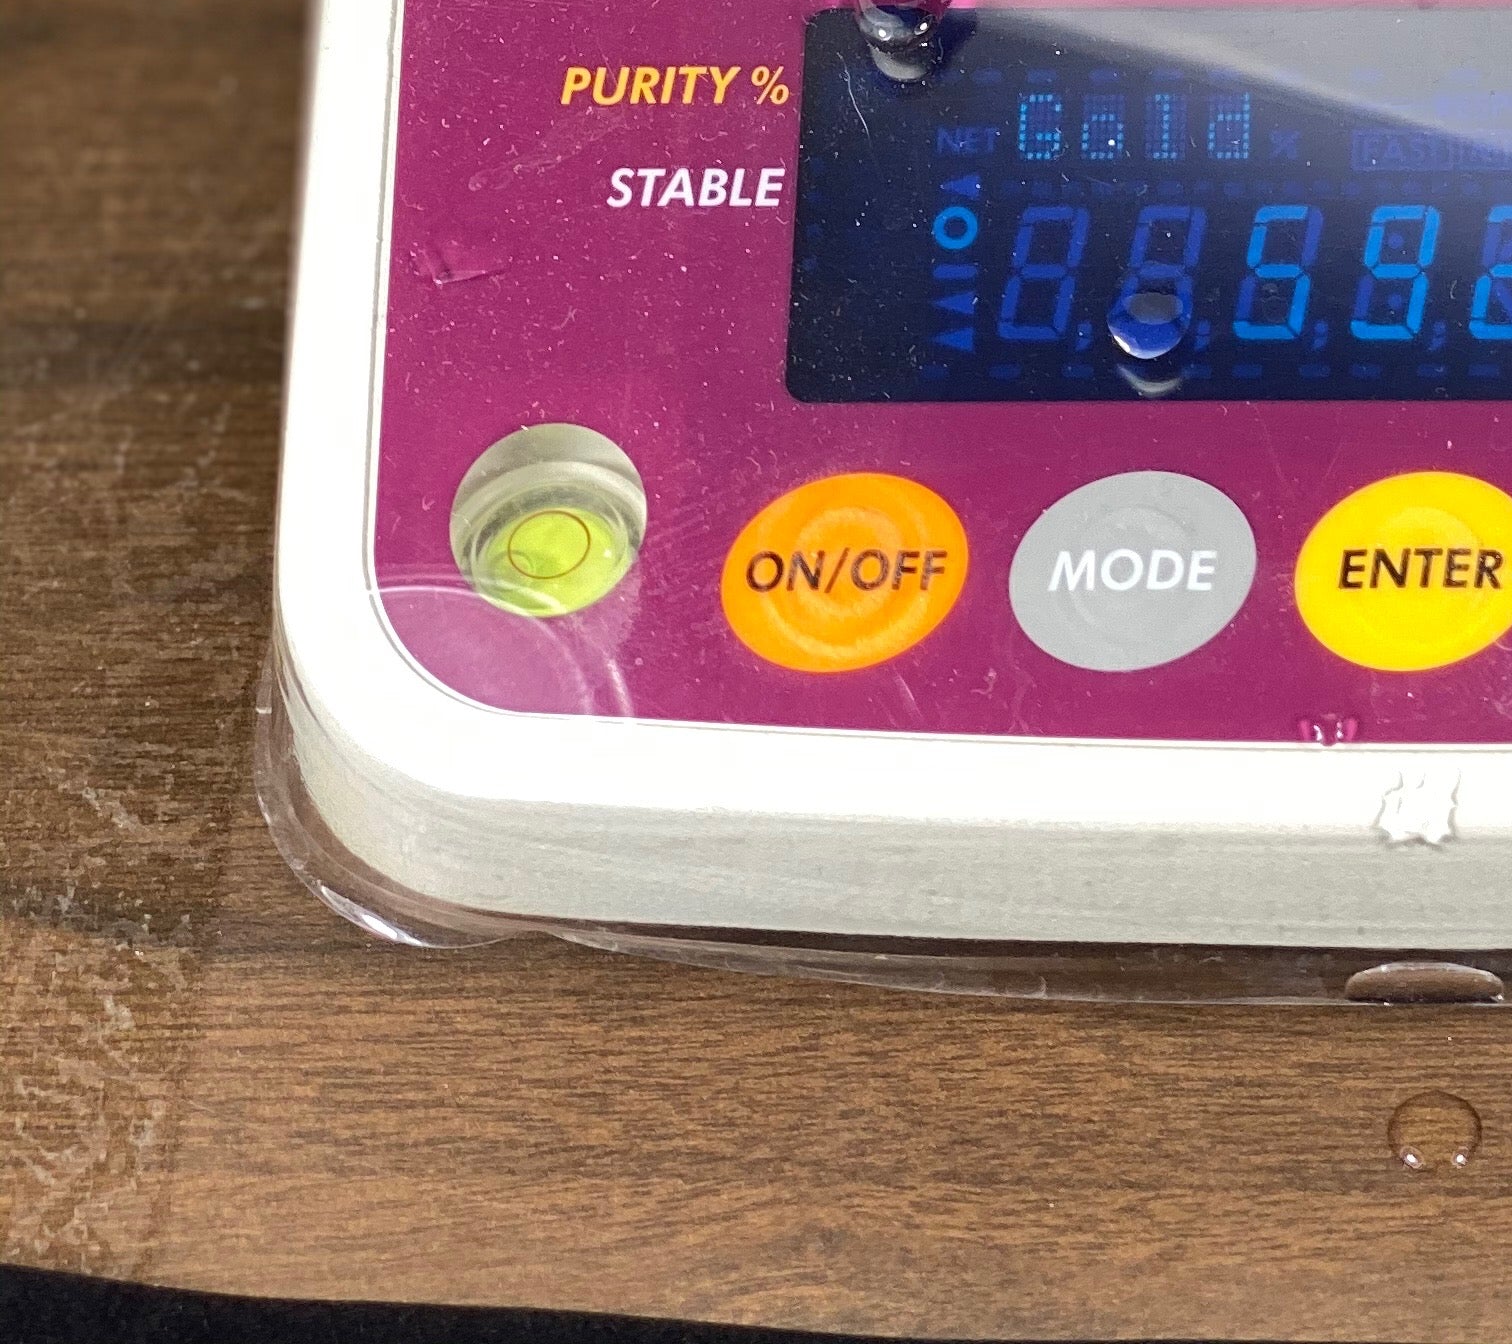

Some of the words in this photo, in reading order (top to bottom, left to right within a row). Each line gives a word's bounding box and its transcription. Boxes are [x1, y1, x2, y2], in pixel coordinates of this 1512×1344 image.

[560, 66, 738, 105] PURITY
[750, 68, 790, 104] %
[1018, 92, 1251, 161] Gold
[606, 166, 783, 208] STABLE
[745, 549, 946, 594] ON/OFF
[1048, 548, 1217, 592] MODE
[1338, 549, 1503, 590] ENTER
